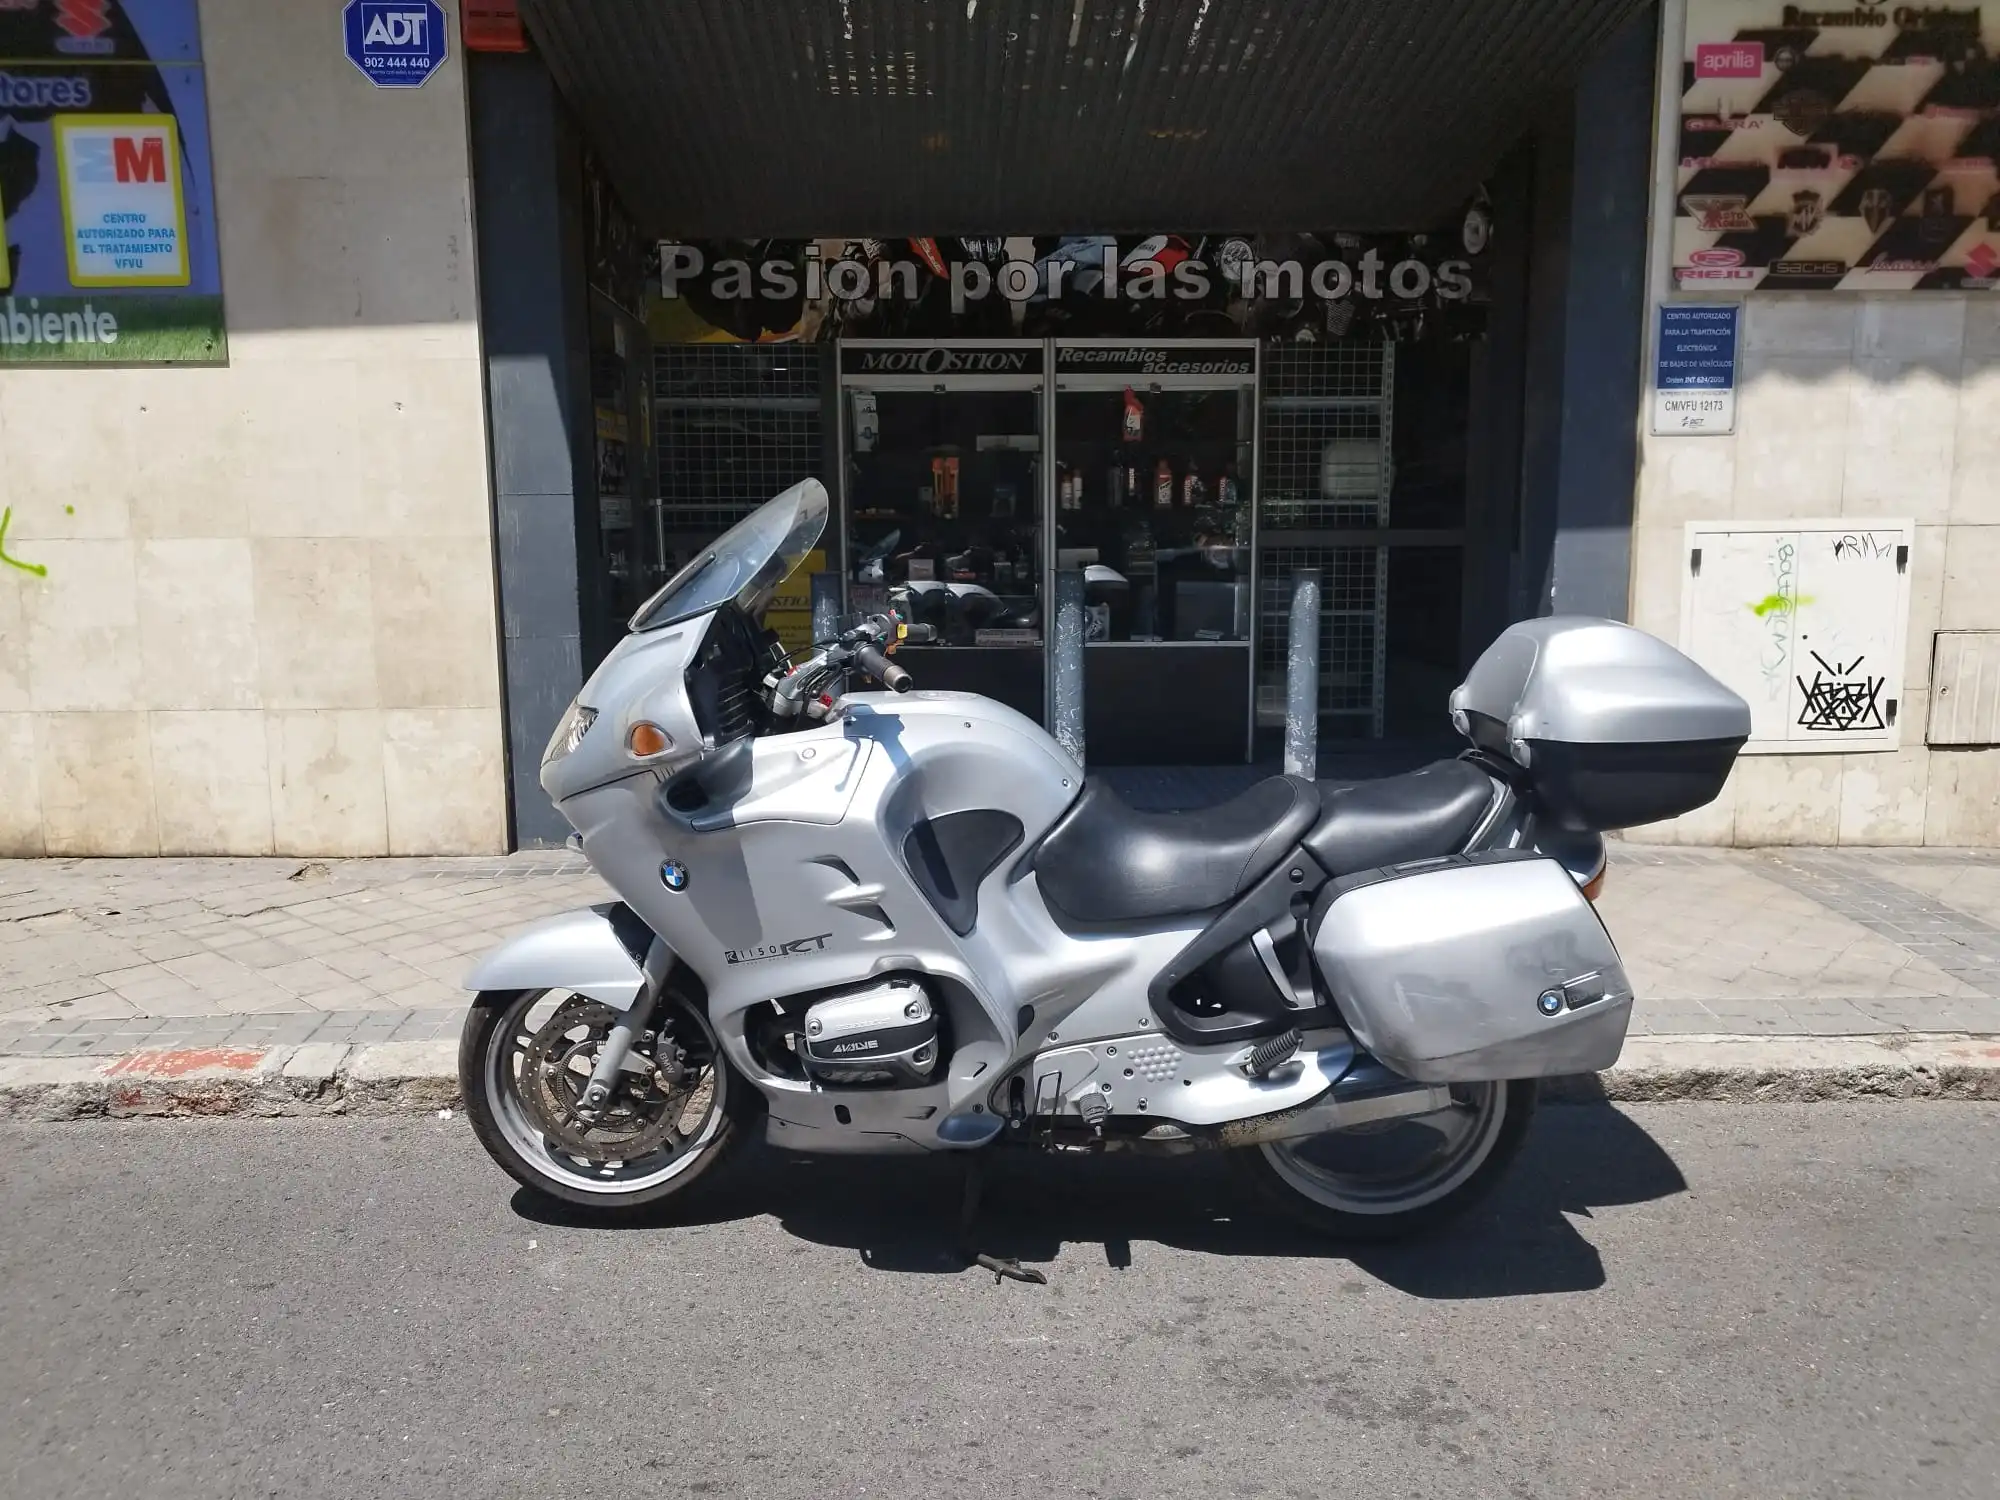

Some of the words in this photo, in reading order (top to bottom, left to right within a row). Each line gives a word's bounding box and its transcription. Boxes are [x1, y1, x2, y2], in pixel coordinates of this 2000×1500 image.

[364, 12, 427, 46] ADT
[364, 57, 385, 68] 902
[387, 57, 407, 68] 444
[410, 57, 430, 69] 440
[1703, 51, 1755, 71] aprilia
[103, 213, 147, 224] CENTRO
[77, 228, 145, 239] AUTORIZADO
[148, 228, 176, 239] PARA
[83, 244, 96, 254] EL
[98, 244, 173, 254] TRATAMIENTO
[115, 258, 144, 269] VFVU
[659, 242, 918, 300] Pasión
[950, 259, 1077, 314] por
[1103, 246, 1208, 300] las
[1240, 248, 1473, 300] motos
[1675, 270, 1754, 279] RIEJU
[1666, 312, 1691, 320] CENTRO
[1692, 312, 1731, 320] AUTORIZADO
[1058, 347, 1167, 364] Recambios
[1142, 358, 1250, 374] accesorios
[1660, 360, 1669, 368] DE
[1670, 360, 1688, 368] BAJAS
[1689, 360, 1698, 368] DE
[1665, 401, 1697, 411] CM/VFU
[1699, 401, 1723, 411] 12173
[659, 1052, 676, 1075] BMW
